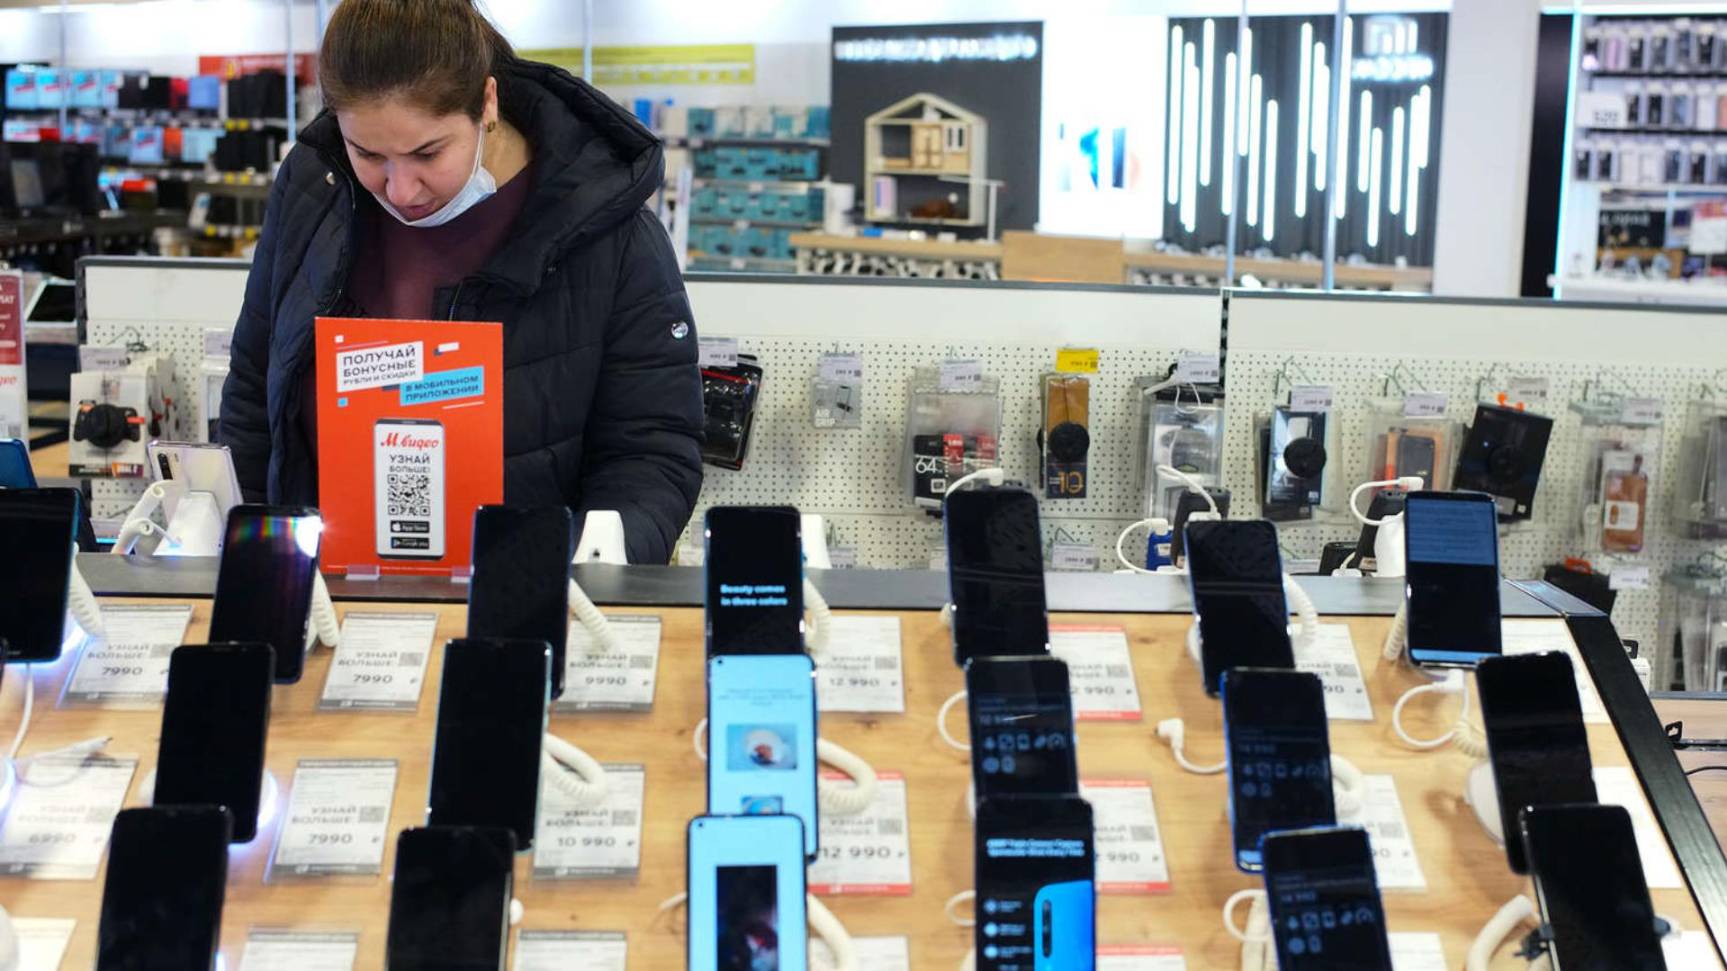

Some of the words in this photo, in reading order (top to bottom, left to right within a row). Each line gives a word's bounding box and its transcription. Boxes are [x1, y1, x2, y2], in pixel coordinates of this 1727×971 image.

[343, 345, 416, 366] ПОЛУЧАЙ
[343, 359, 415, 377] БОНУСНЫЕ
[343, 375, 372, 385] РУБЛИ
[381, 370, 416, 381] СКИДКИ
[414, 376, 479, 391] МОБИЛЬНОМ
[405, 385, 479, 401] ПРИЛОЖЕНИИ
[389, 453, 431, 464] УЗНАЙ
[915, 456, 937, 474] 64
[101, 666, 143, 676] 7990
[353, 674, 393, 684] 7990
[585, 677, 627, 686] 9990
[829, 679, 844, 687] 12
[848, 679, 880, 687] 990
[1084, 685, 1116, 694] 990
[307, 833, 353, 844] 7990
[557, 837, 577, 847] 10
[582, 837, 616, 847] 990
[822, 847, 842, 858] 12
[849, 847, 891, 859] 990
[1106, 853, 1140, 863] 990
